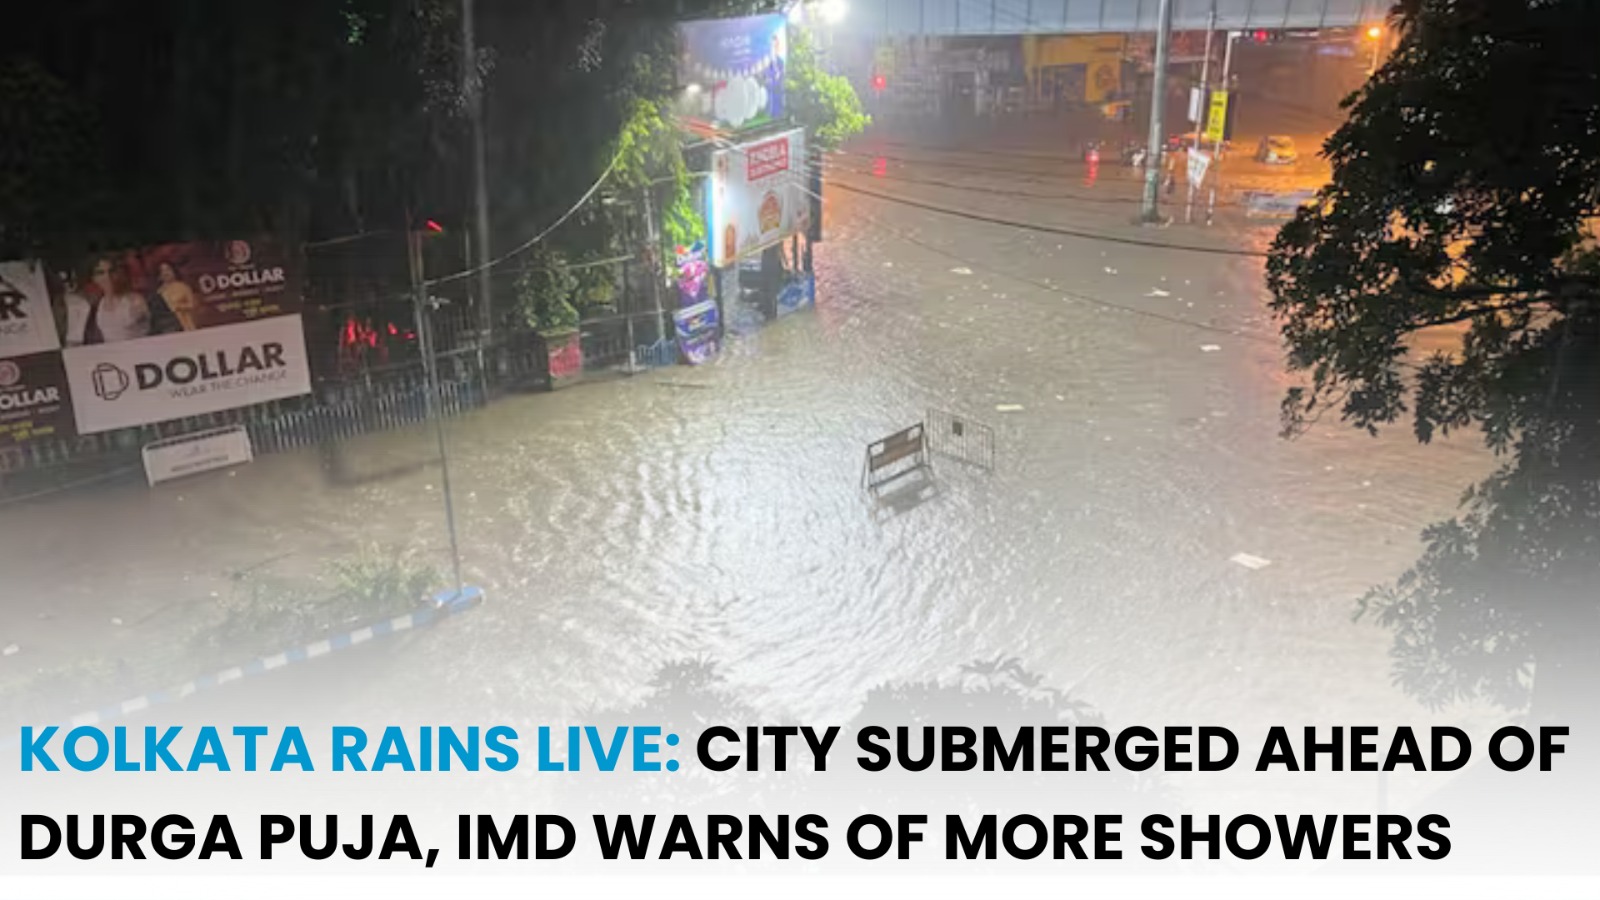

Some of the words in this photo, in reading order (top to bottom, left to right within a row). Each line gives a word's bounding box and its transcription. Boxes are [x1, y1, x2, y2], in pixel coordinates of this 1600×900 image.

[217, 268, 284, 288] DOLLAR
[134, 342, 287, 391] DOLLAR
[170, 385, 206, 399] WEAR
[210, 378, 234, 390] THE
